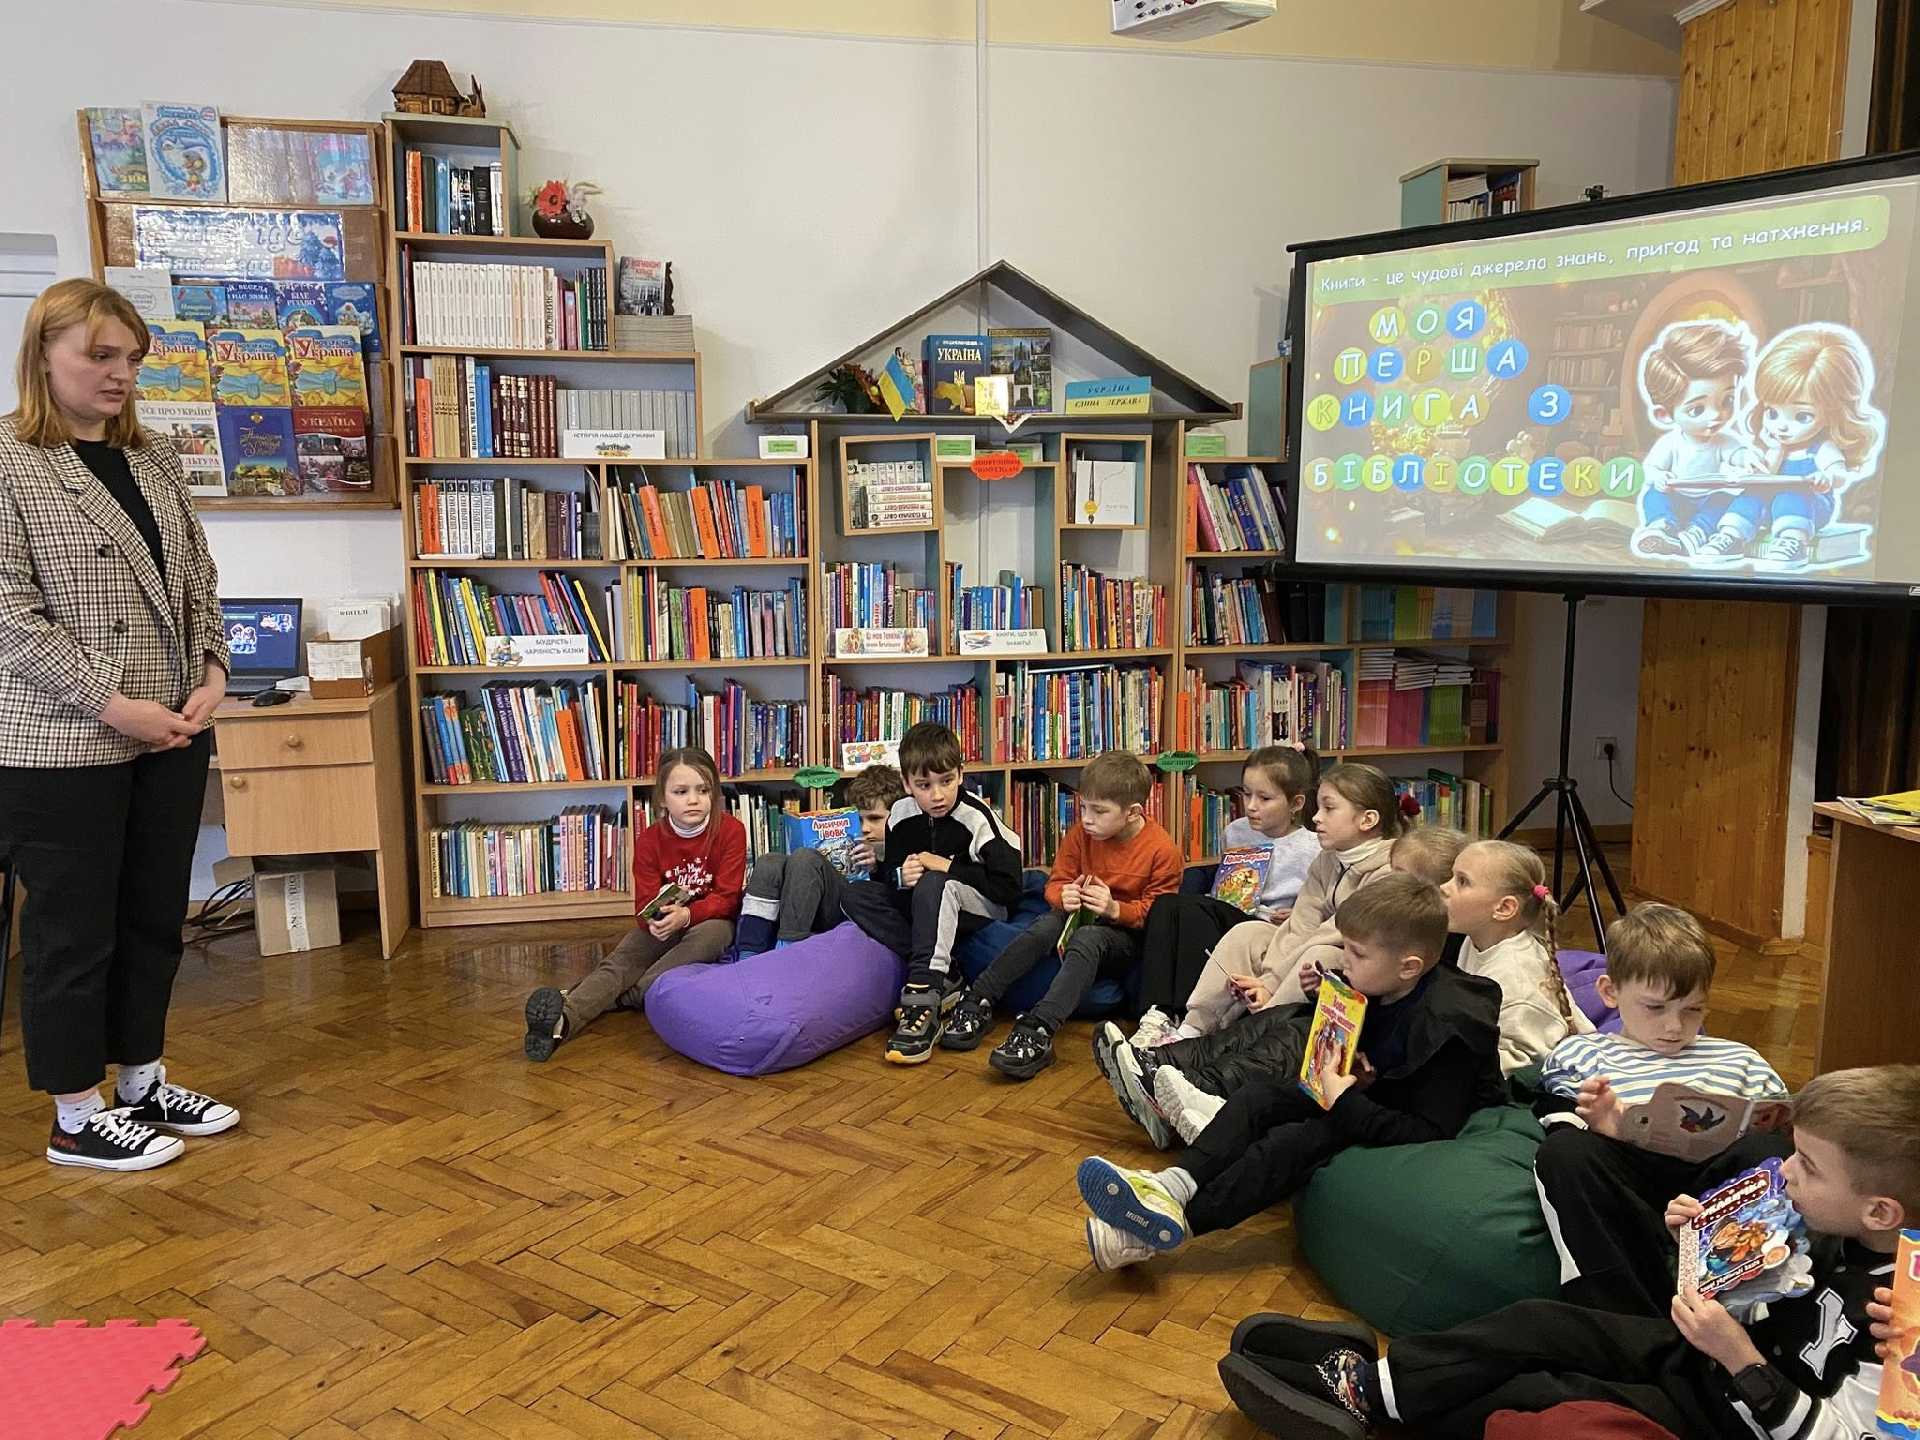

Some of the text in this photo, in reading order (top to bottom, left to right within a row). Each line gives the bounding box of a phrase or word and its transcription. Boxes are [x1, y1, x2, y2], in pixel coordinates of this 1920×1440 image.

[1320, 276, 1366, 292] Книги
[1386, 271, 1404, 287] це
[1411, 264, 1465, 285] чудові
[1470, 256, 1547, 277] джерела
[1555, 251, 1614, 268] знань,
[1626, 239, 1700, 263] пригод
[1711, 234, 1733, 250] та
[1742, 217, 1870, 246] натхнення.
[1376, 307, 1475, 337] МОЯ
[218, 342, 278, 362] Україна
[295, 338, 354, 361] Україна
[937, 347, 982, 361] УКРАЇНА
[1340, 347, 1516, 379] ПЕРША
[301, 415, 356, 427] УКРАЇНА
[1316, 394, 1480, 424] КНИГА
[1313, 460, 1637, 491] БІБЛІОТЕКИ
